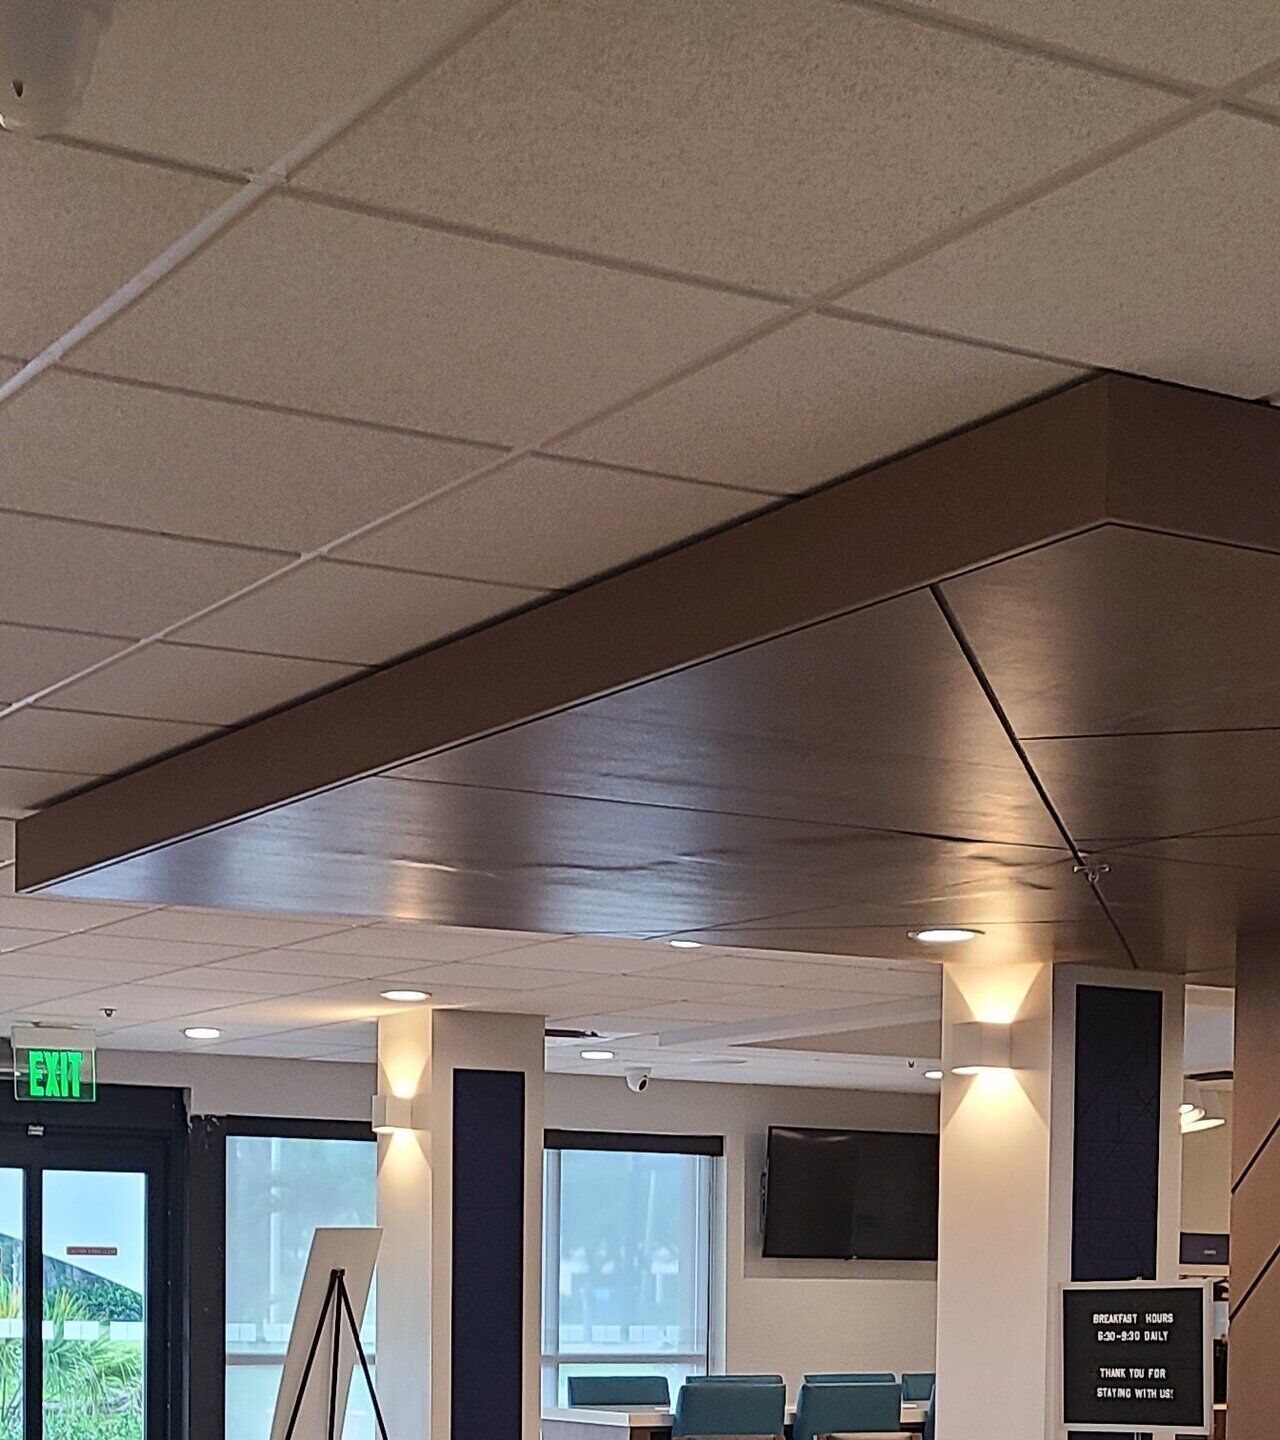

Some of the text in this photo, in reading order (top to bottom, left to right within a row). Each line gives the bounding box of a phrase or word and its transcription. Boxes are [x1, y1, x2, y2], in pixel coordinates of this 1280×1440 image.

[29, 1051, 83, 1097] EXIT
[1092, 1313, 1174, 1324] BREAKFAST HOURS
[1144, 1330, 1169, 1342] DAILY
[1099, 1367, 1166, 1379] THANK YOU FOR
[1096, 1387, 1174, 1400] STAYING WITH US!
